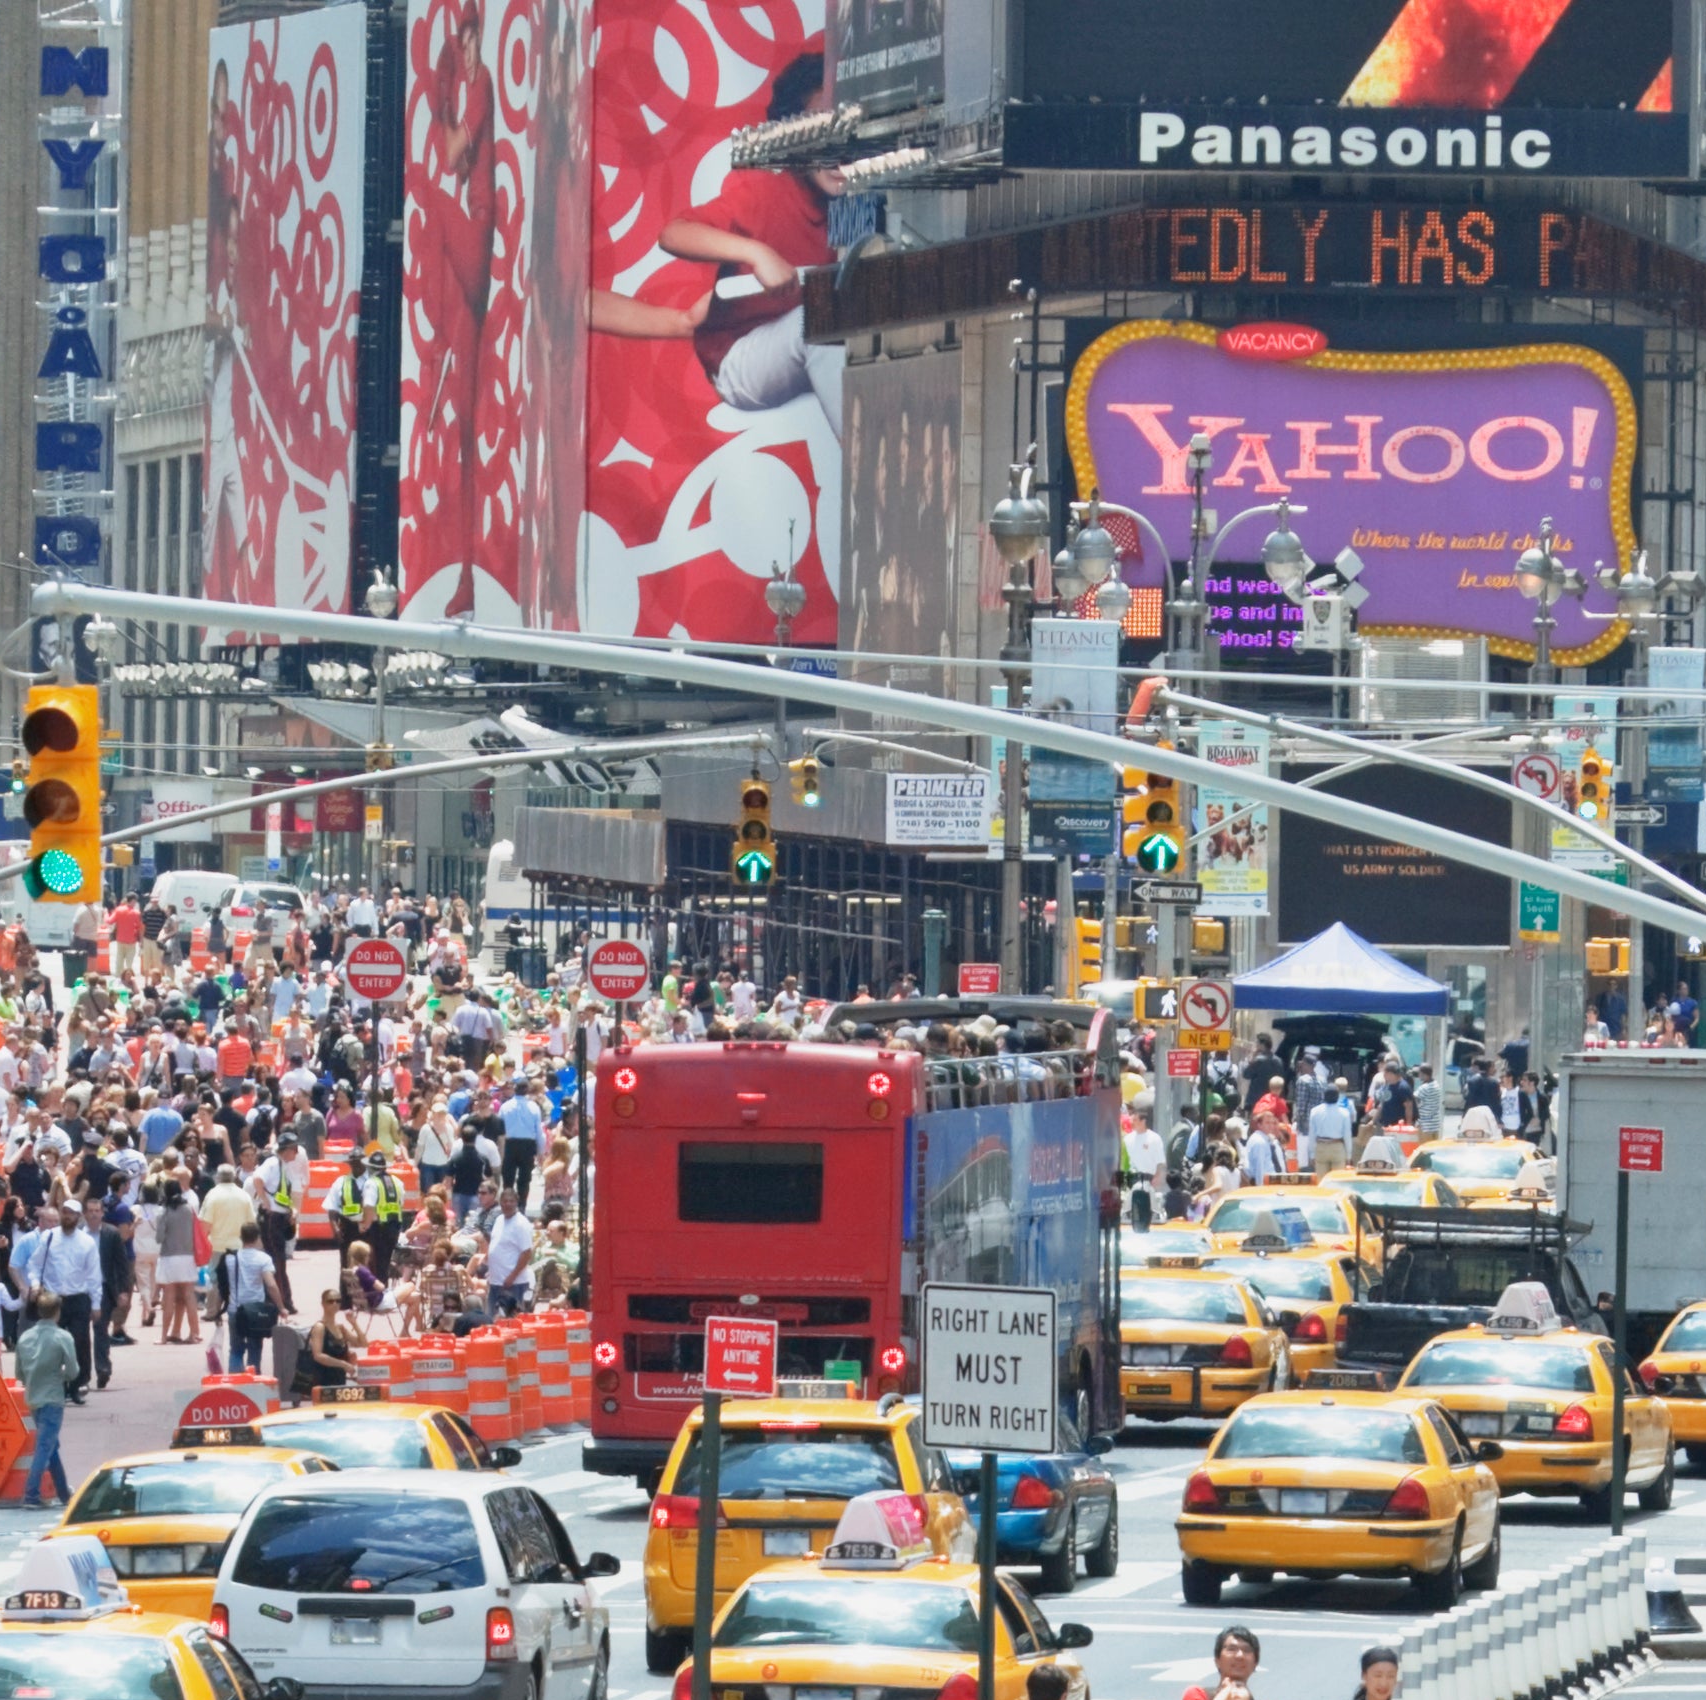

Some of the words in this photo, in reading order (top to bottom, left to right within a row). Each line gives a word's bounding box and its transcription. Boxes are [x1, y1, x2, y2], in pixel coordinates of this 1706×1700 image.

[1138, 113, 1552, 169] Panasonic
[1370, 209, 1495, 286] HAS
[1226, 331, 1320, 352] VACANCY
[1352, 527, 1411, 549] Where
[1416, 528, 1445, 549] the
[1449, 530, 1506, 551] world
[1036, 630, 1116, 646] TITANIC
[1206, 746, 1261, 763] BROADWAY
[895, 779, 985, 797] PERIMETER
[1353, 846, 1363, 855] IS
[1343, 865, 1355, 875] US
[1358, 865, 1394, 875] ARMY
[1141, 886, 1165, 897] ONE
[1170, 887, 1194, 898] WAY
[1526, 904, 1553, 913] South
[356, 951, 370, 962] DO
[373, 951, 395, 962] NOT
[599, 951, 615, 962] DO
[618, 951, 638, 962] NOT
[358, 977, 392, 989] ENTER
[601, 977, 635, 989] ENTER
[1188, 1033, 1220, 1046] NEW
[932, 1307, 989, 1333] RIGHT
[998, 1311, 1048, 1336] LANE
[713, 1328, 726, 1343] NO
[729, 1329, 771, 1345] STOPPING
[723, 1350, 760, 1365] ANYTIME
[956, 1354, 1021, 1385] MUST
[192, 1407, 215, 1423] DO
[218, 1404, 249, 1421] NOT
[930, 1402, 981, 1427] TURN
[990, 1404, 1048, 1432] RIGHT
[844, 1544, 876, 1558] 7E35
[24, 1593, 60, 1609] 7F13
